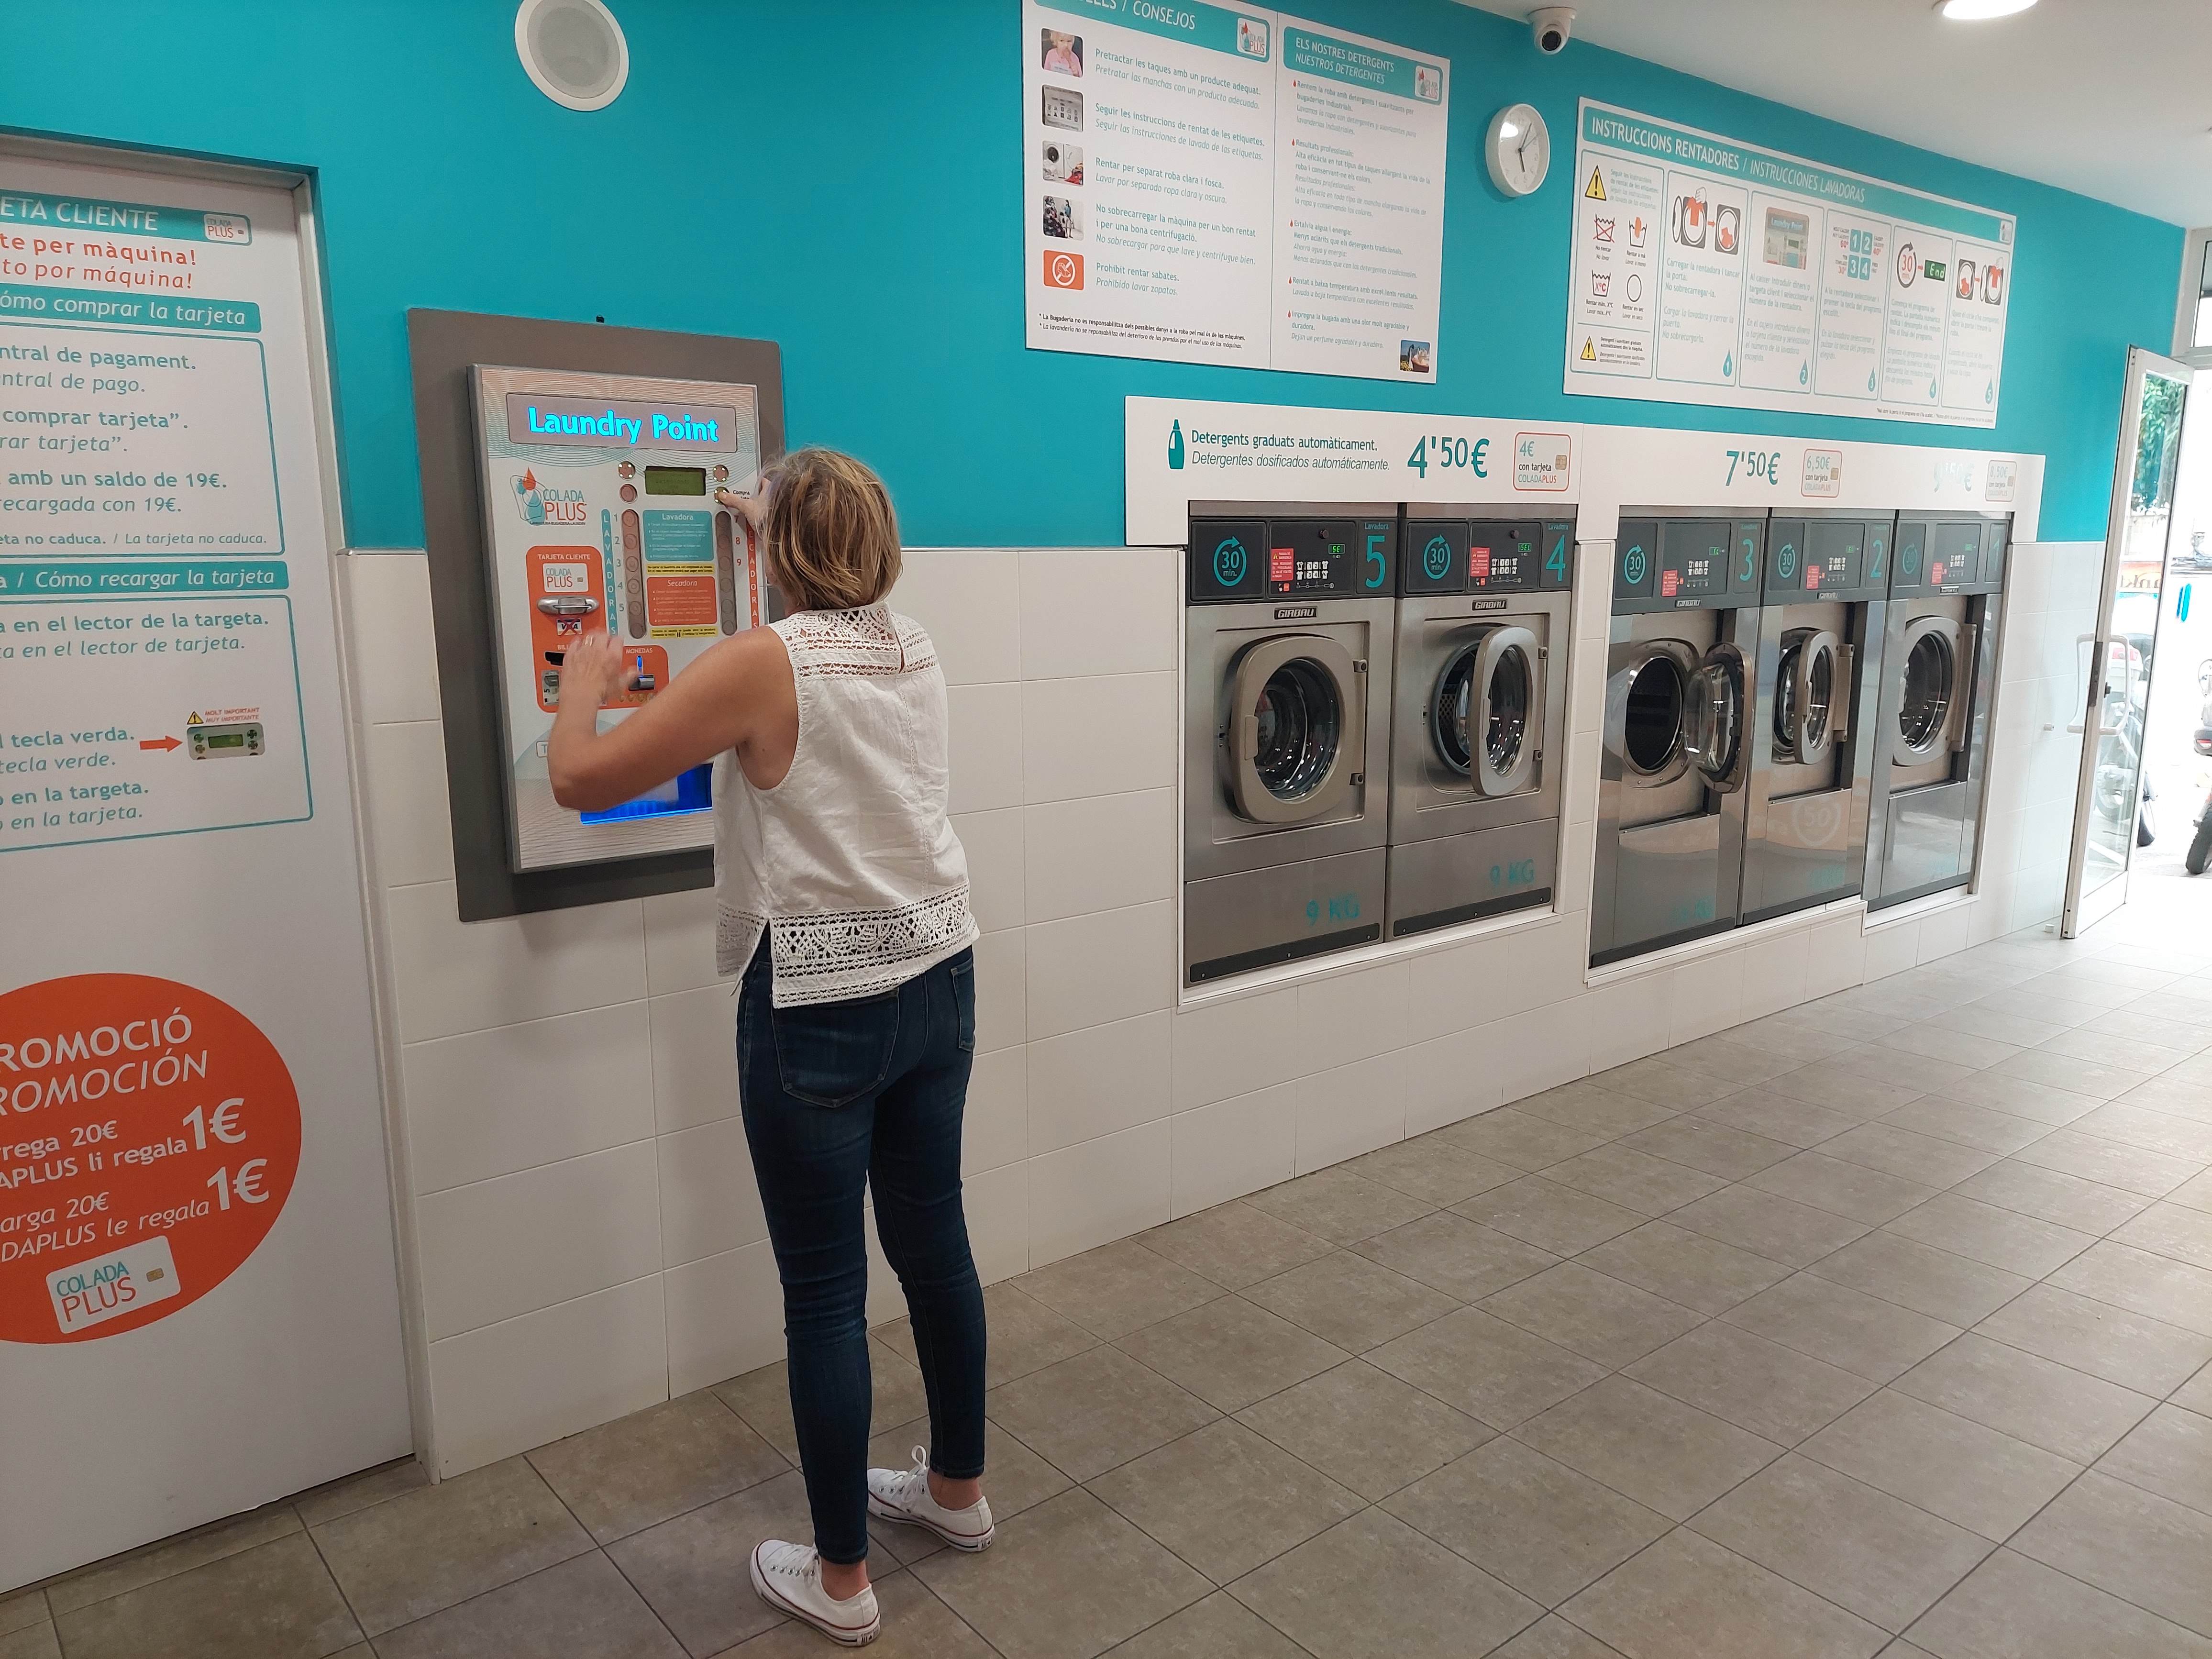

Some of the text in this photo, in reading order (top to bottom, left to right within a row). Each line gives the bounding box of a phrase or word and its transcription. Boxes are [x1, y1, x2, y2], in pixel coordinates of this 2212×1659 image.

[1133, 0, 1195, 30] CONSEJOS
[1296, 37, 1394, 72] ELS NOSTRES DETERGENTS
[1096, 48, 1133, 64] Pretractar
[1136, 58, 1145, 68] les
[1148, 62, 1171, 74] taques
[1173, 69, 1187, 77] amb
[1201, 76, 1230, 88] producte
[1233, 83, 1261, 95] adequat.
[1295, 53, 1384, 84] NUESTROS DETERGENTES
[1096, 103, 1264, 146] Seguir les instruccions de rentat de les etiquetes.
[1593, 117, 1865, 202] INSTRUCCIONS RENTADORES INSTRUCCIONES LAVADORAS
[1096, 157, 1224, 188] Rentar per separat roba clara fosca.
[56, 202, 159, 232] CLIENTE
[34, 239, 196, 267] per màquina!
[1853, 234, 1857, 248] 1
[1864, 237, 1870, 251] 2
[35, 265, 191, 288] por máquina!
[1096, 262, 1179, 281] Prohibit rentar sabates.
[1850, 260, 1868, 276] 3 4
[1901, 254, 1913, 272] 30
[1930, 263, 1945, 278] End
[1096, 277, 1177, 295] Prohibido lavar zapatos.
[54, 299, 244, 325] comprar la tarjeta
[57, 347, 196, 369] de pagament.
[528, 407, 719, 444] Laundry Point
[1192, 430, 1377, 451] Detergents graduats automàticament.
[1519, 441, 1534, 457] 4€
[1192, 451, 1389, 470] Detergentes dosificados automáticamente.
[1407, 435, 1490, 478] 4'50€
[1807, 456, 1831, 471] 6,50€
[9, 470, 226, 487] amb un saldo de 19€.
[1518, 463, 1551, 473] con tarjeta
[1518, 474, 1557, 483] COLADAPLUS
[1725, 450, 1781, 486] 7'50€
[543, 489, 584, 502] COLADA
[544, 502, 586, 521] PLUS
[614, 513, 618, 522] 1
[49, 533, 106, 544] caduca.
[126, 534, 140, 544] La
[146, 533, 193, 546] tarjeta
[219, 533, 266, 543] caduca.
[615, 536, 620, 544] 2
[616, 559, 621, 567] 3
[1221, 551, 1239, 569] 30
[1365, 535, 1385, 588] 5
[1430, 548, 1445, 564] 30
[1546, 535, 1566, 581] 4
[1629, 556, 1641, 570] 30
[1740, 539, 1753, 581] 3
[1782, 553, 1792, 566] 30
[1870, 540, 1883, 577] 2
[36, 570, 274, 589] Cómo recargar la tarjeta
[547, 576, 573, 587] PLUS
[619, 604, 624, 612] 5
[1278, 608, 1314, 618] GIRBAU
[14, 612, 268, 632] en el lector de la targeta.
[11, 727, 134, 747] tecla verda.
[1306, 900, 1319, 926] 9
[70, 1120, 118, 1147] 20€
[89, 1097, 247, 1172] li regala 1€
[66, 1192, 109, 1219] 20€
[107, 1217, 126, 1237] le
[138, 1200, 210, 1230] regala
[207, 1158, 269, 1211] 1€
[56, 1261, 129, 1297] COLADA
[61, 1278, 136, 1322] PLUS
